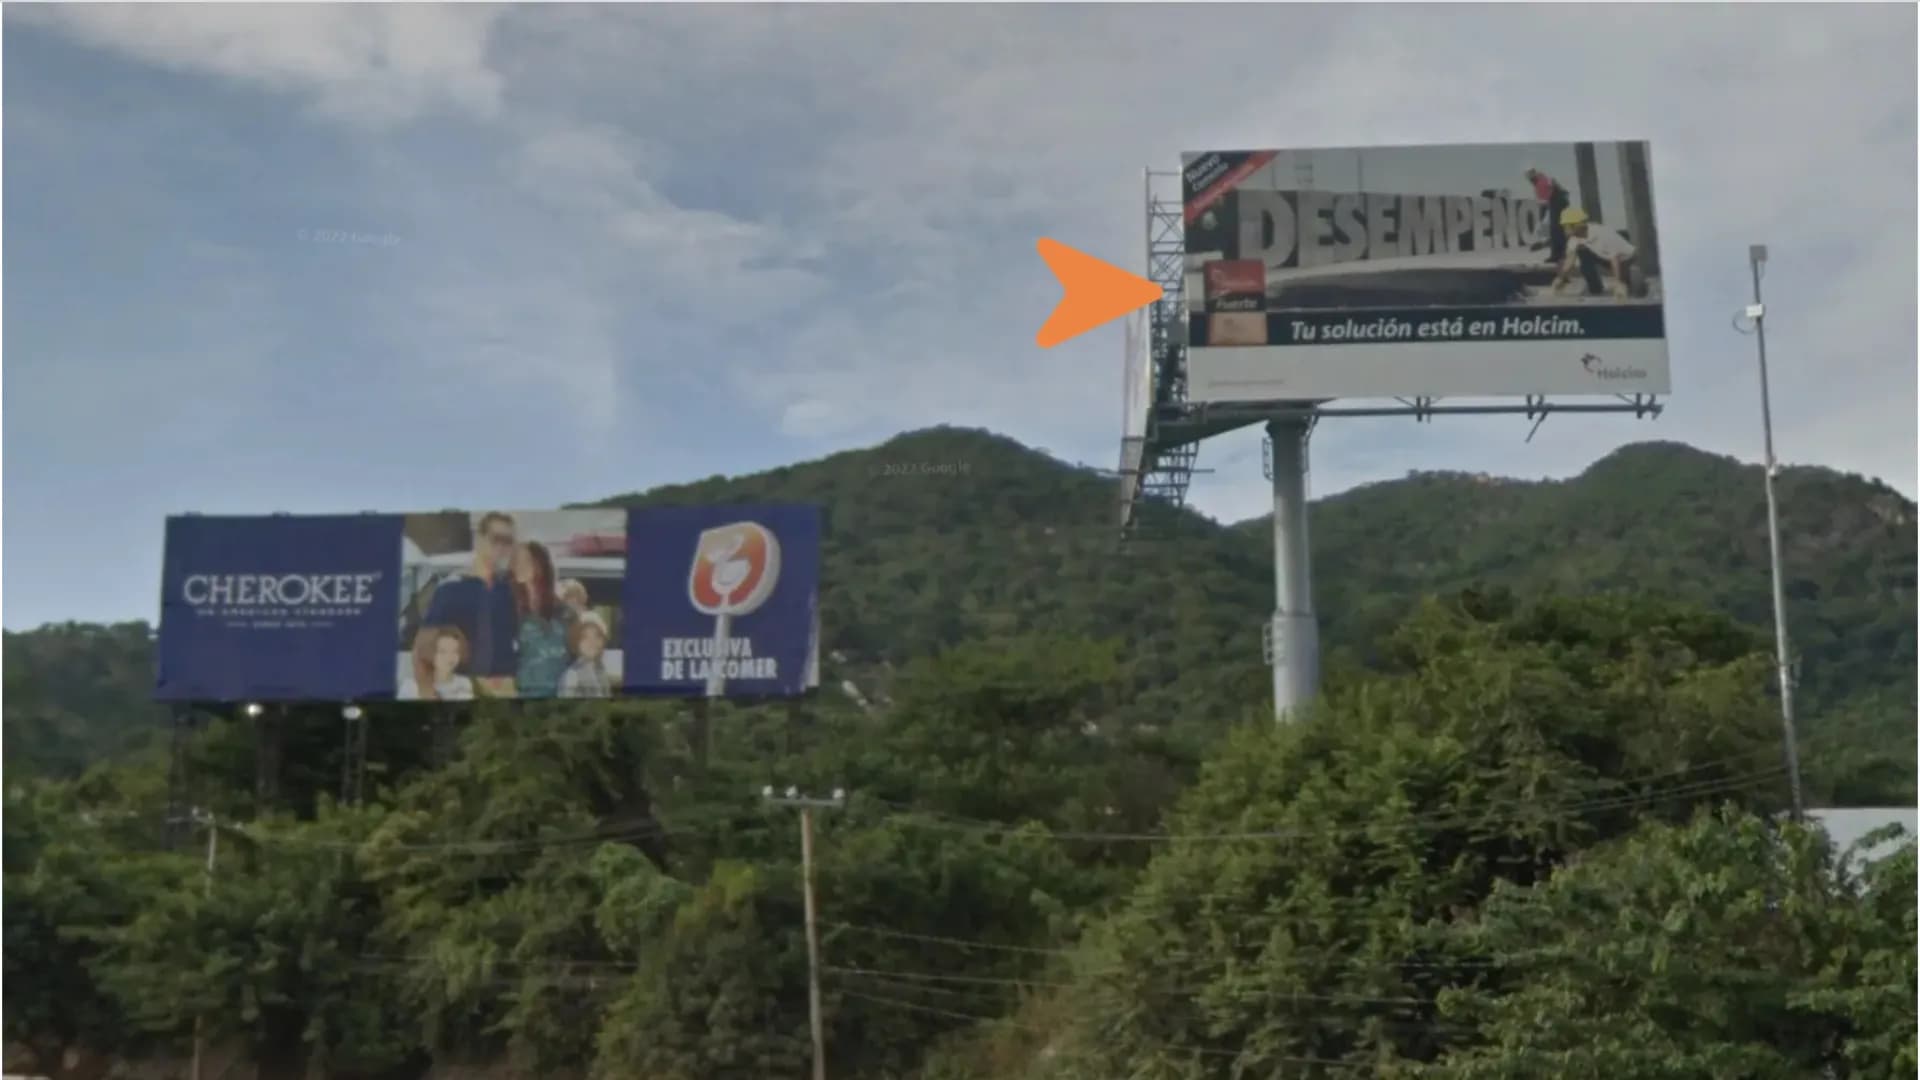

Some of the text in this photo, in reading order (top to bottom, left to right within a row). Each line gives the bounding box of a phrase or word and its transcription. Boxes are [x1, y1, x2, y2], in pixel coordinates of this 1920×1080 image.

[1237, 188, 1545, 268] DESEMPEÑO
[1291, 315, 1586, 340] Tu solución está en Holcim.
[184, 573, 374, 605] CHEROKEE
[661, 659, 683, 680] DE
